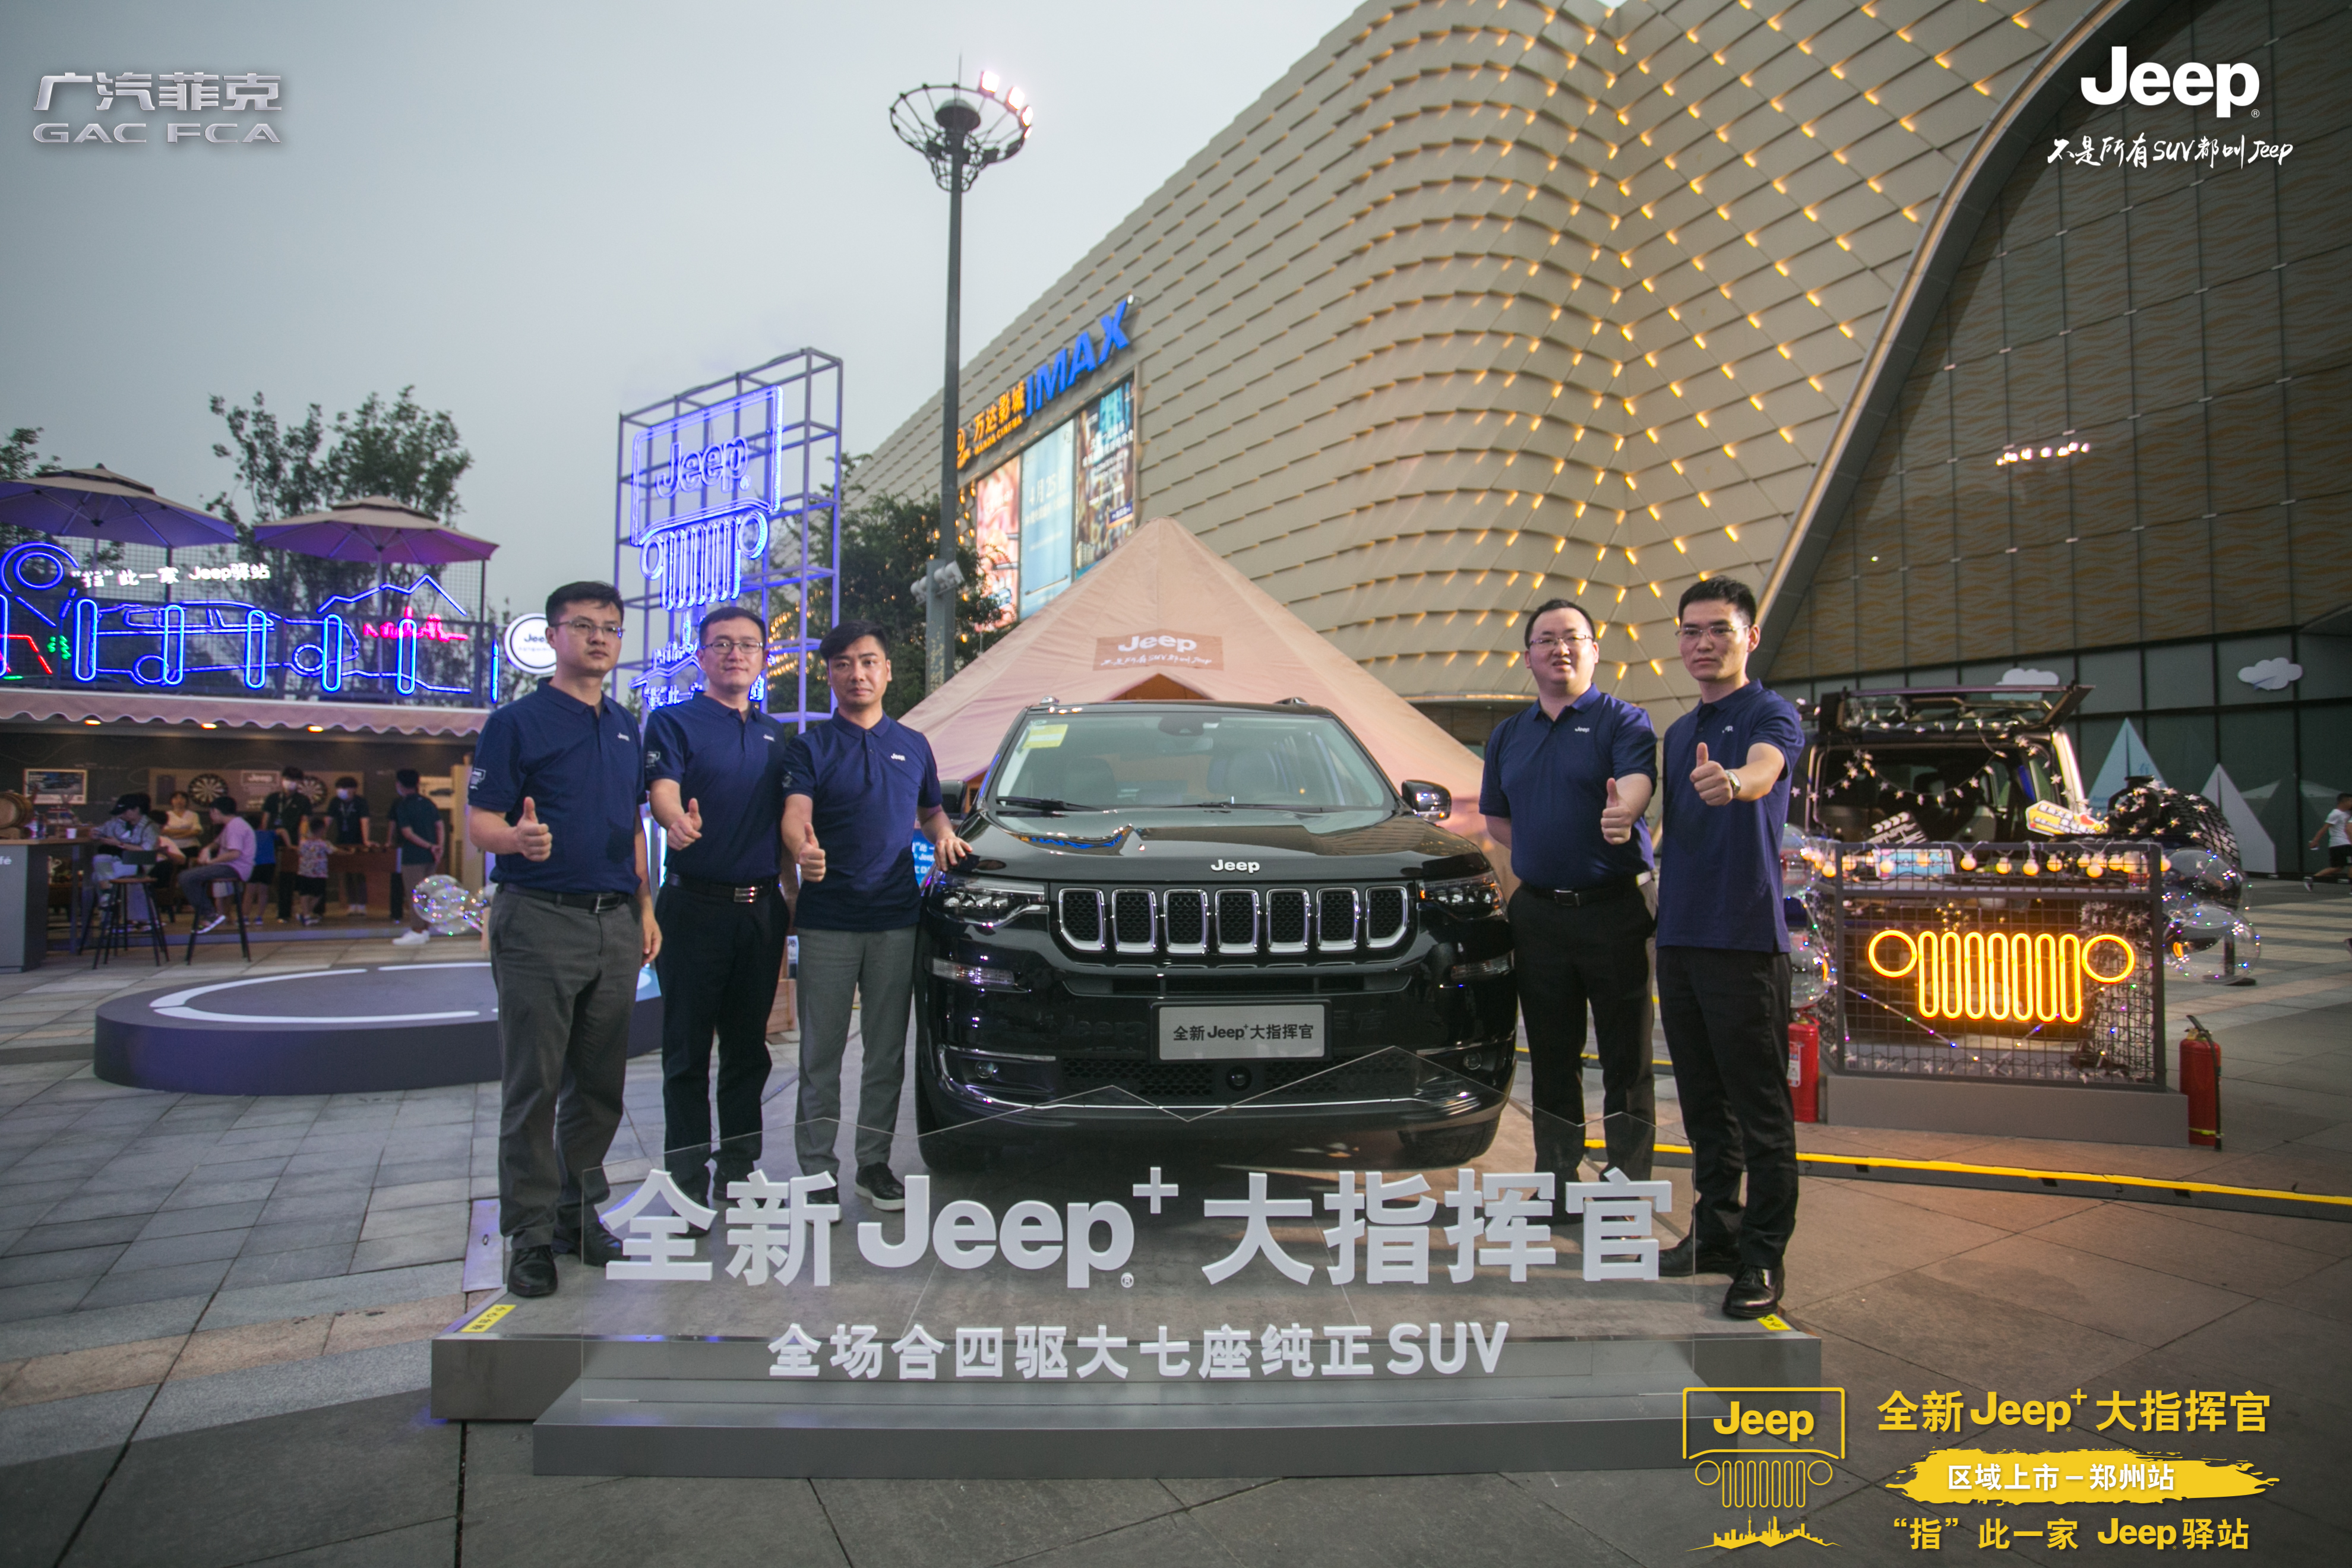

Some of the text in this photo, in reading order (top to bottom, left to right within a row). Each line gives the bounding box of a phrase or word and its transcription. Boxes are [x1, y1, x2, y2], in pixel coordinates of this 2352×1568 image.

[1026, 300, 1129, 417] IMAX
[973, 381, 1025, 442] 万达影城
[996, 415, 1023, 440] CINEMA
[655, 436, 748, 498] Jeep
[118, 567, 179, 586] 此一家
[188, 562, 271, 581] Jeep驿站
[524, 633, 545, 642] Jee
[1118, 635, 1197, 652] Jeep
[1210, 859, 1260, 874] Jeep
